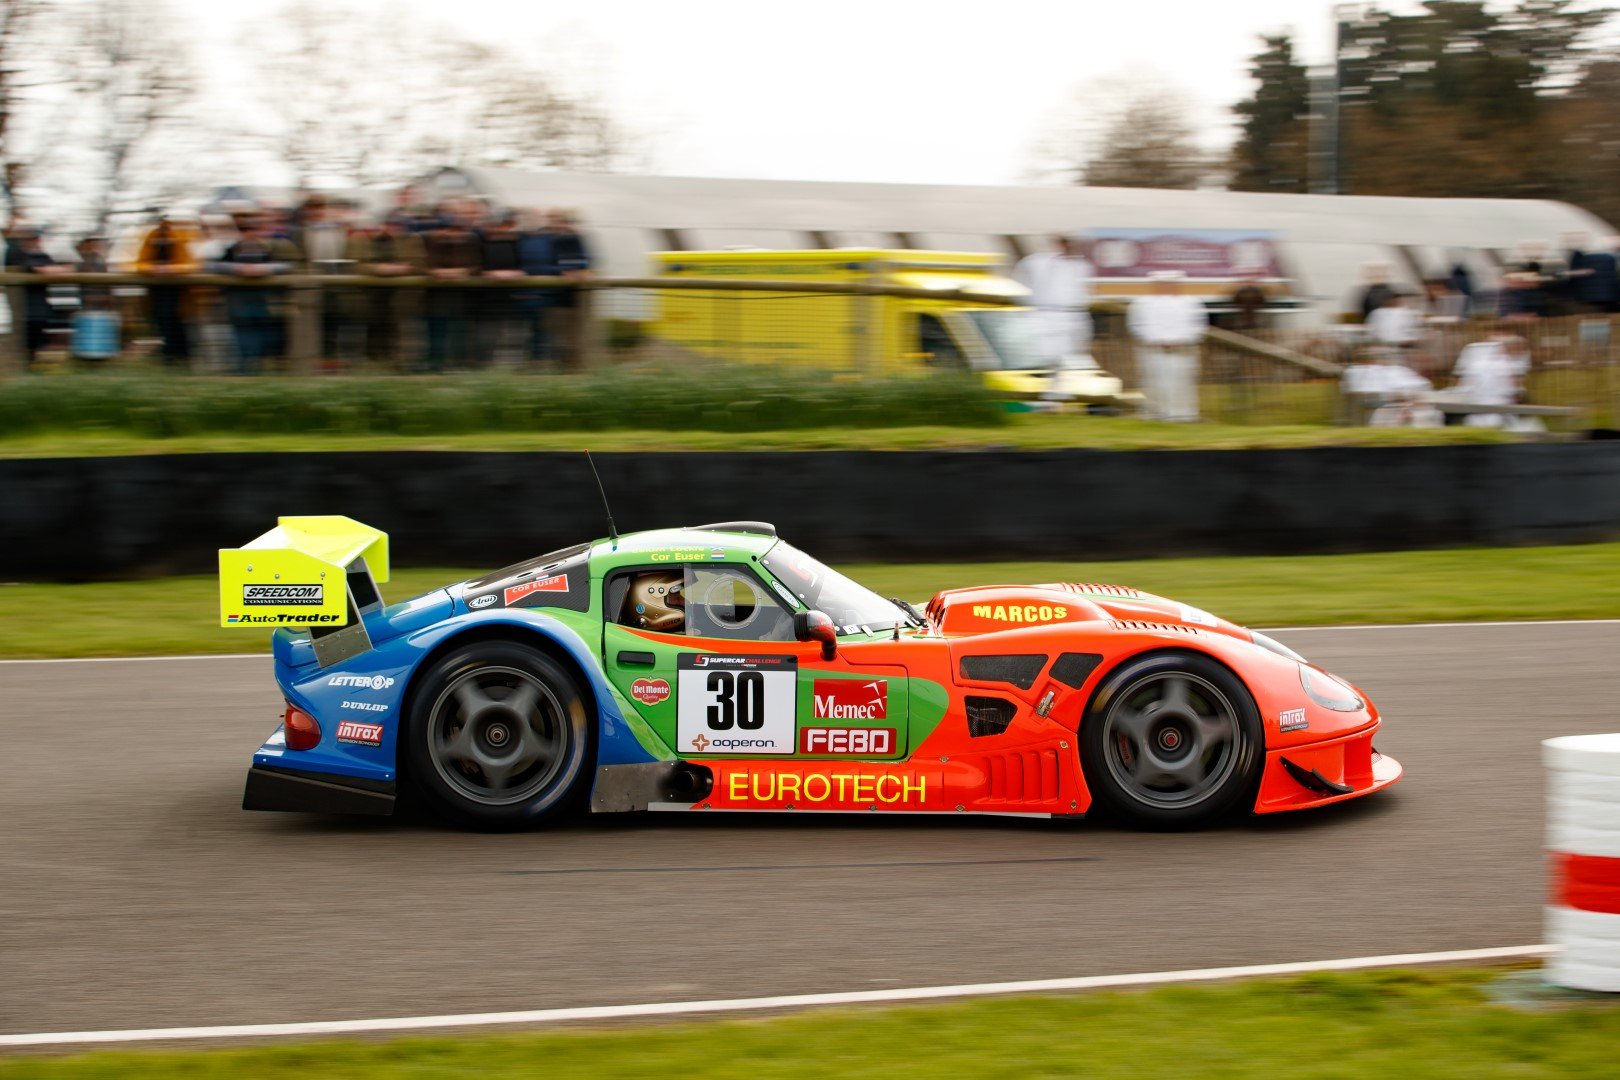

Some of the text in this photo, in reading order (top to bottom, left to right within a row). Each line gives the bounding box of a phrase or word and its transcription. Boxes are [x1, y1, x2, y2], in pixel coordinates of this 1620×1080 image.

[651, 552, 705, 561] Cor Euser
[246, 587, 319, 598] SPEEDCOM
[511, 577, 560, 593] COR EUSER
[239, 613, 340, 623] AutoTrader
[973, 605, 1068, 623] MARCOS
[709, 656, 746, 664] SUPERCAR
[328, 675, 395, 690] LETTEROP
[633, 685, 669, 694] Del Monte
[340, 700, 389, 712] DUNLOP
[706, 671, 765, 731] 30
[814, 694, 876, 719] Memec
[807, 728, 889, 753] FEBO
[729, 773, 926, 803] EUROTECH
